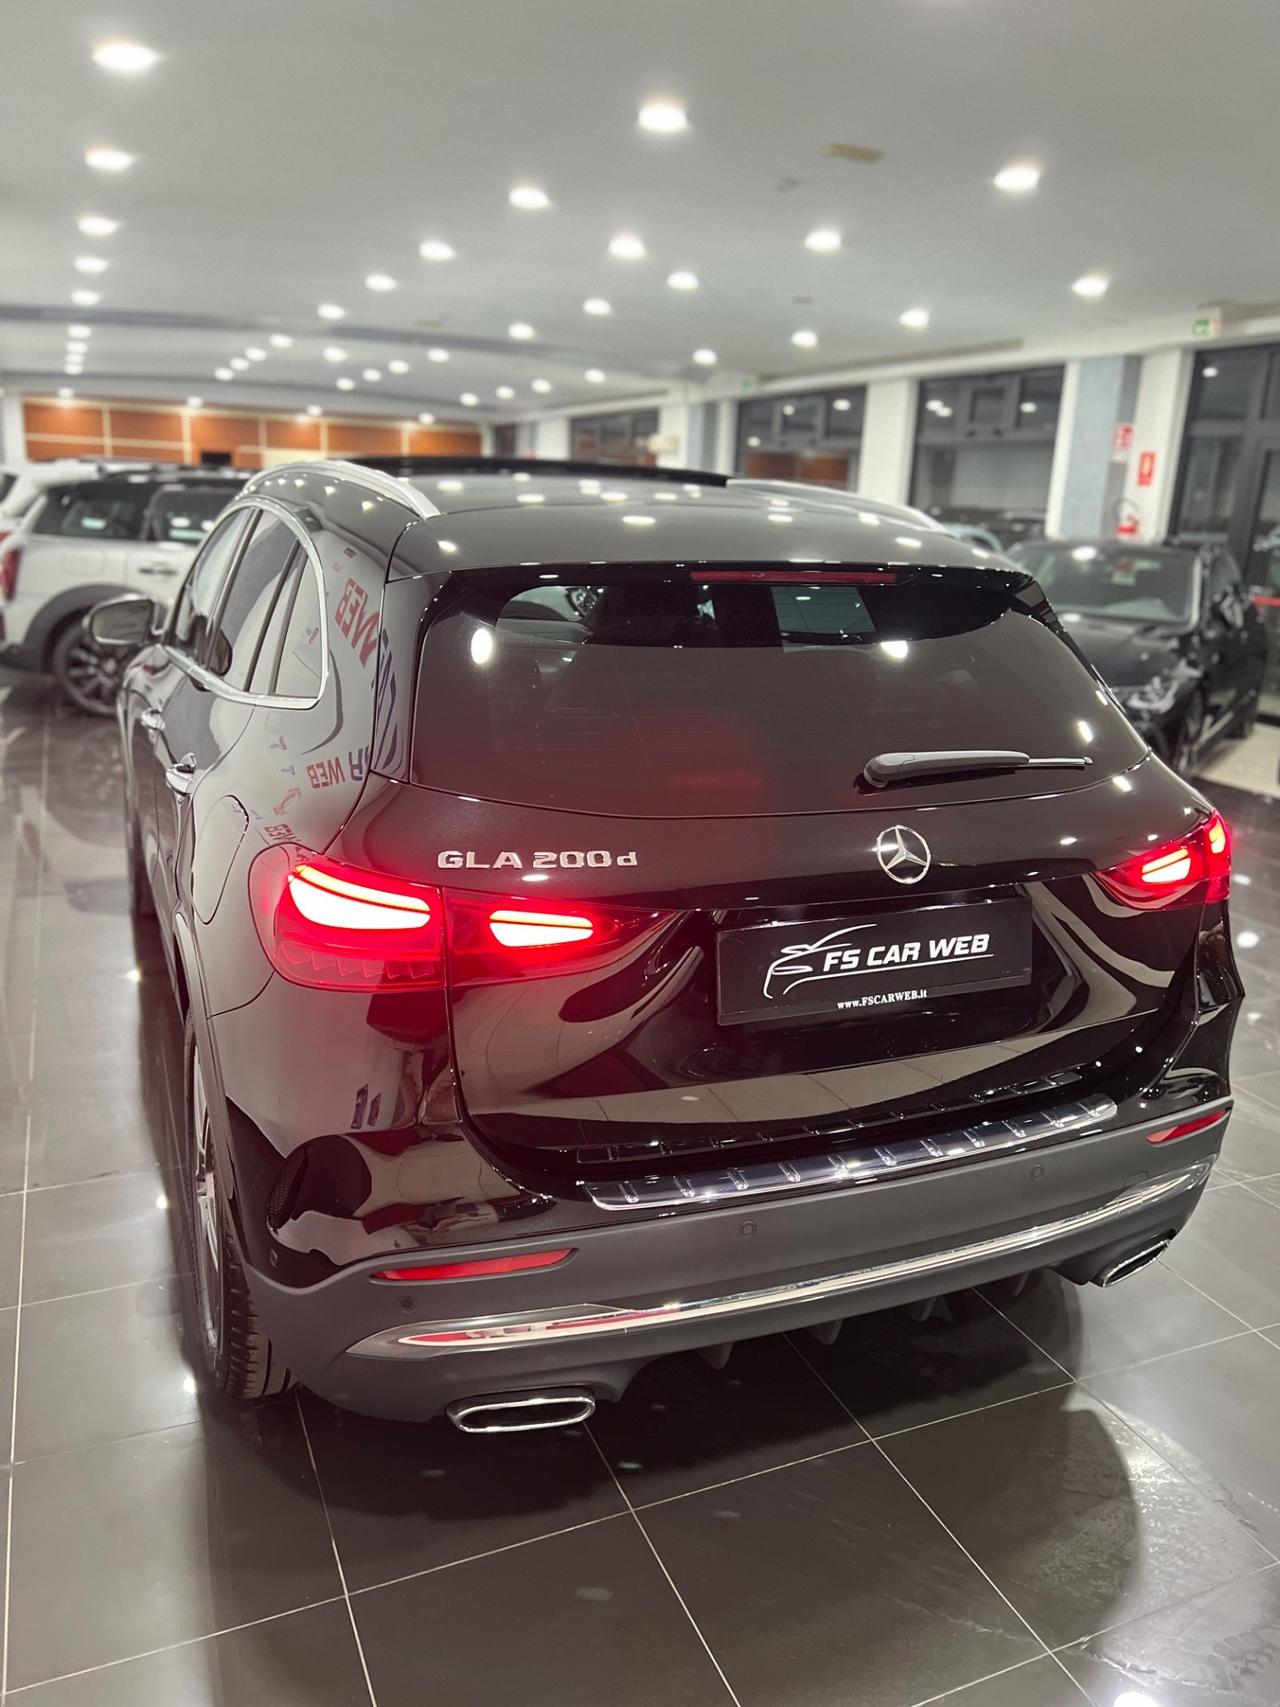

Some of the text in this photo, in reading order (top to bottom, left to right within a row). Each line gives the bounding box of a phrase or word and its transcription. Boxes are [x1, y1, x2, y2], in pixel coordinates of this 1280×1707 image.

[437, 850, 523, 869] GLA
[823, 933, 990, 972] FS CAR WEB
[837, 989, 928, 1010] www.FSCARWEB.it
